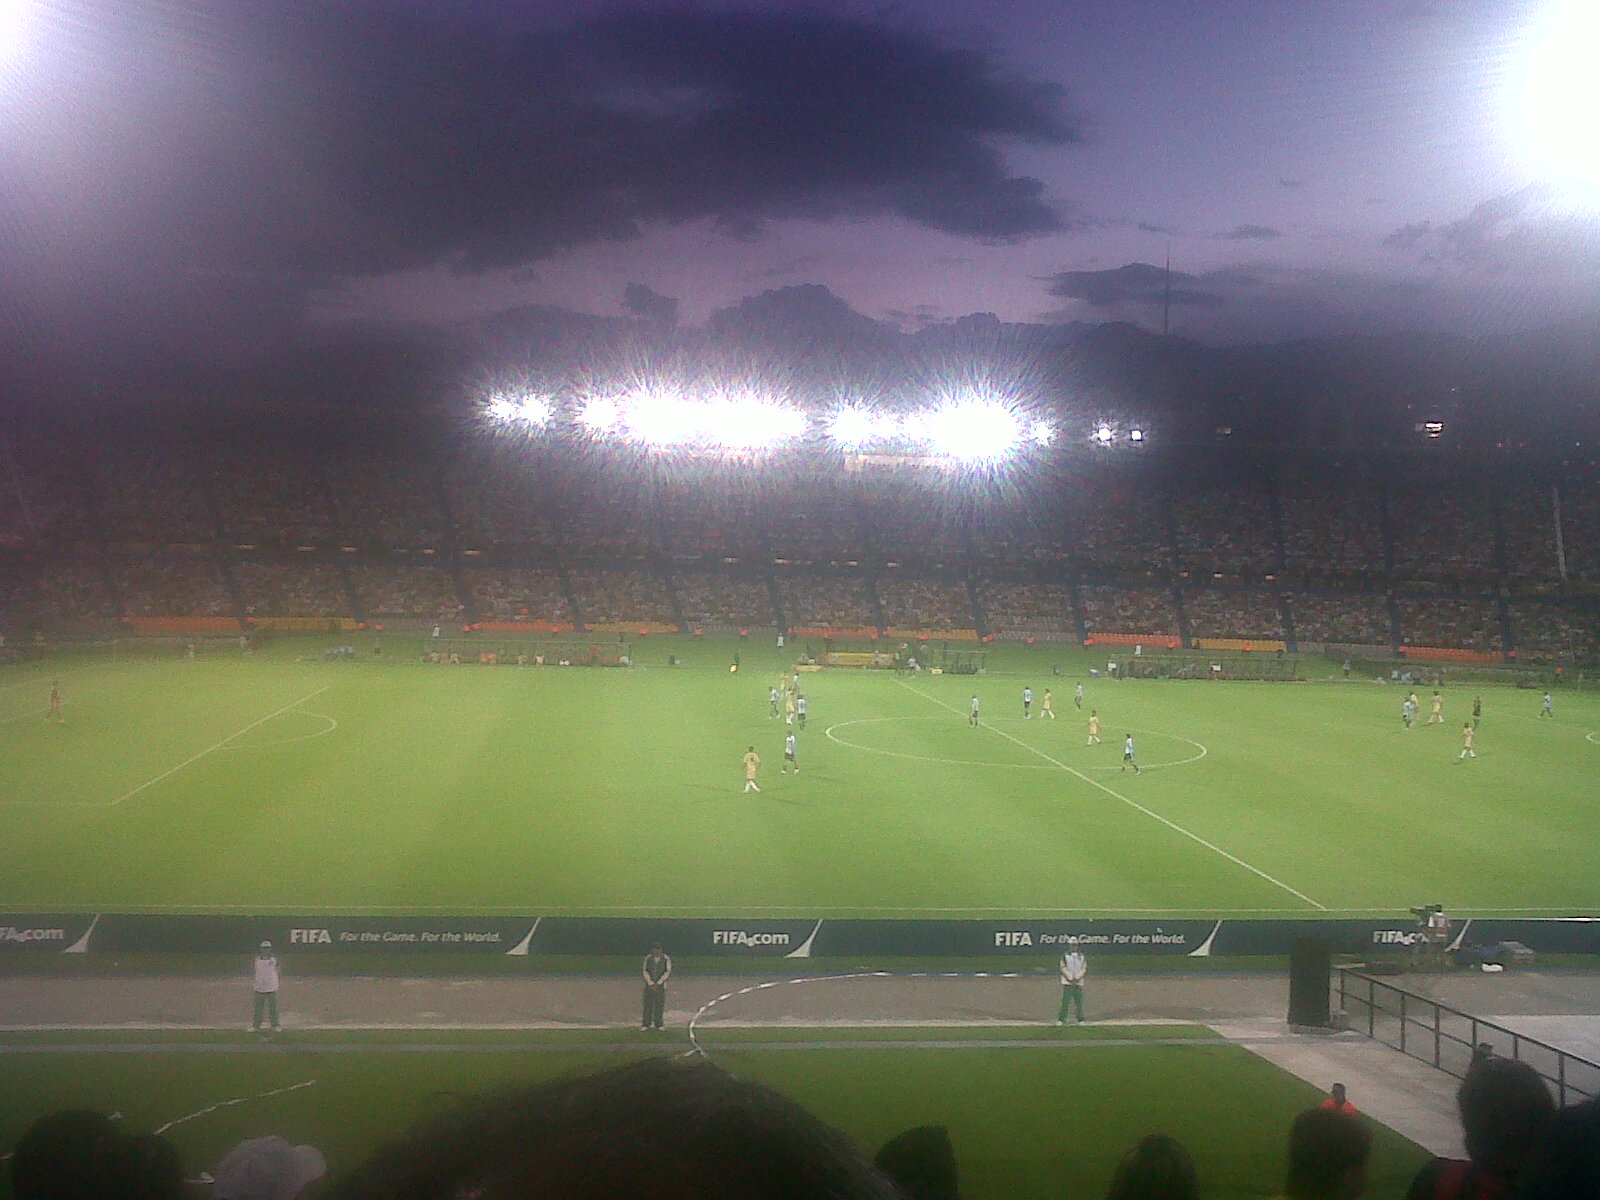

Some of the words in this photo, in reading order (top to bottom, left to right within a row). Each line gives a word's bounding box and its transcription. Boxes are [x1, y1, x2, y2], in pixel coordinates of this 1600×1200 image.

[290, 929, 332, 944] FIFA
[340, 932, 359, 941] For
[360, 932, 381, 941] the
[421, 932, 440, 941] For
[441, 932, 461, 941] the
[713, 931, 790, 946] FIFA.com
[995, 932, 1032, 946] FIFA
[1040, 934, 1059, 944] For
[1113, 934, 1131, 944] For
[1131, 934, 1151, 944] the
